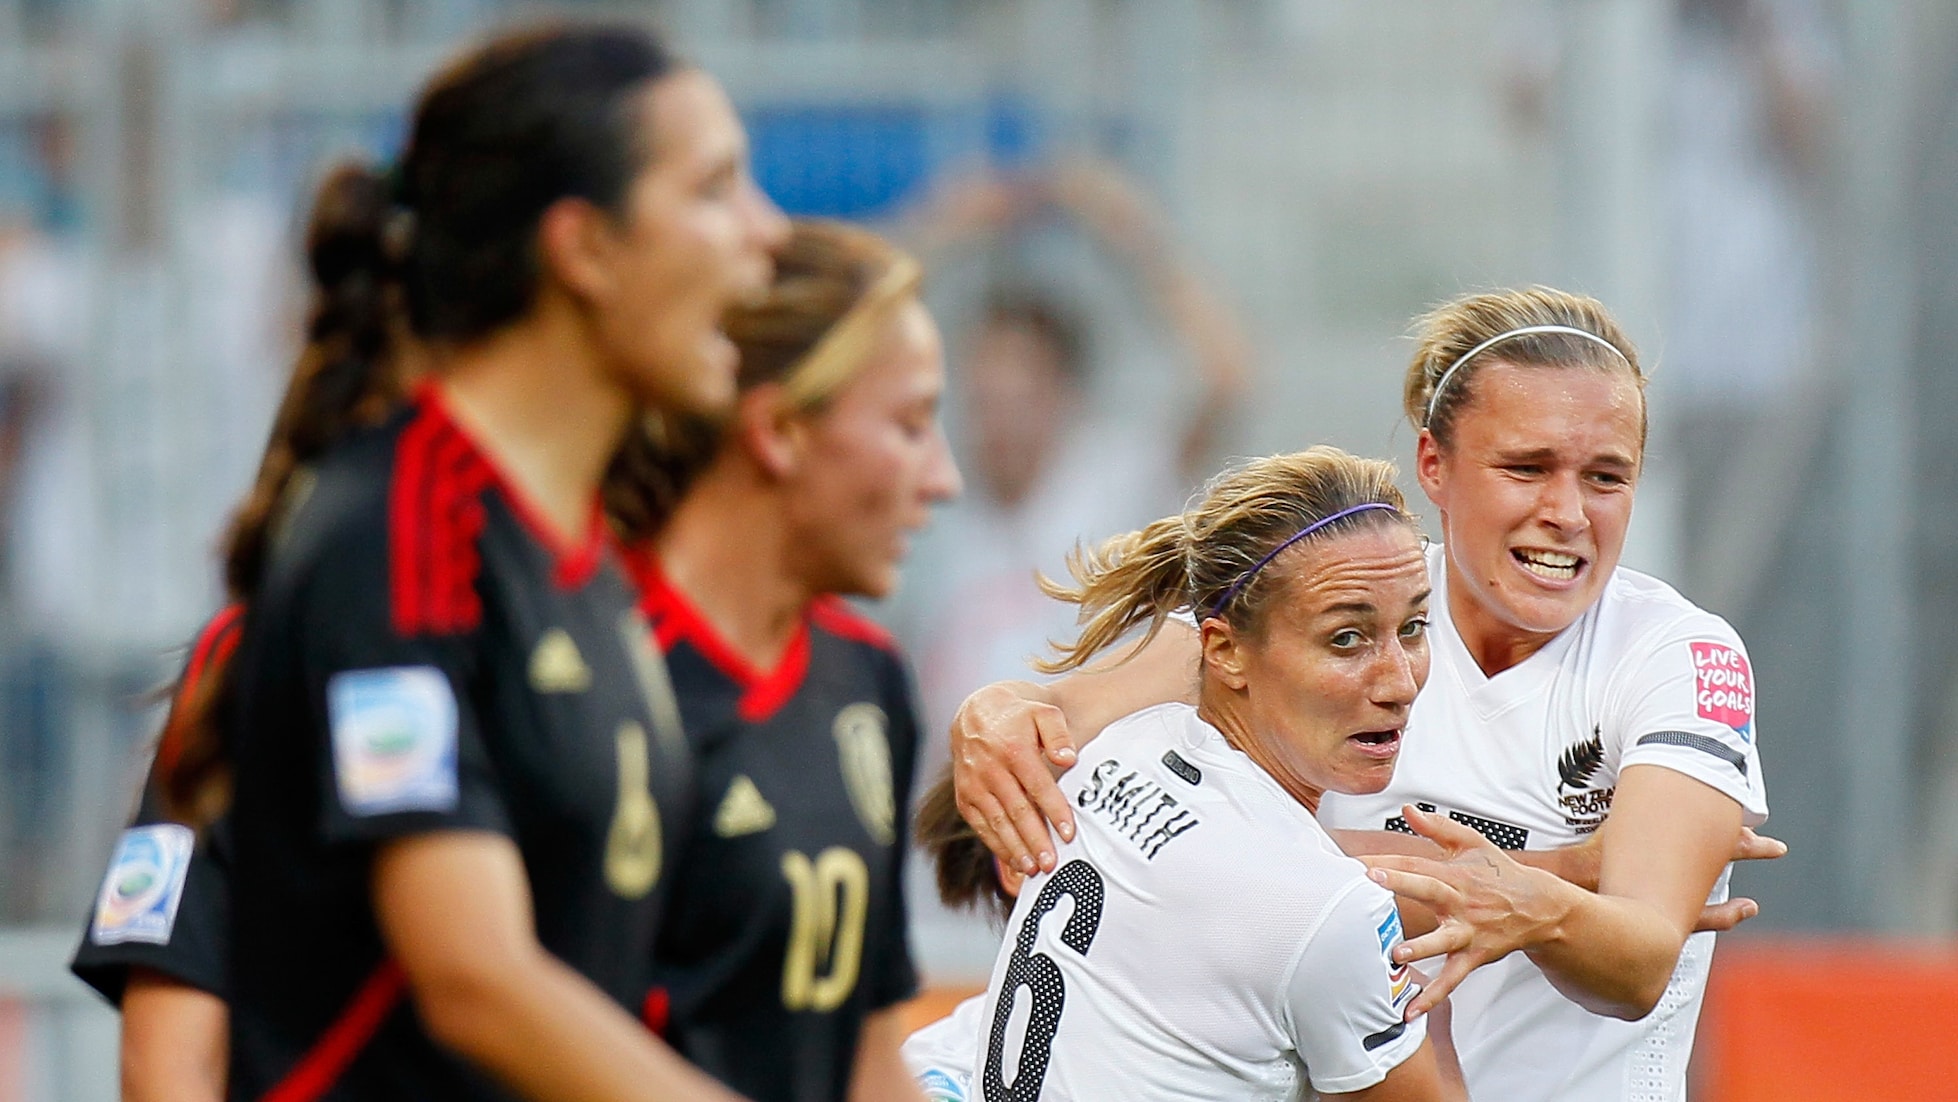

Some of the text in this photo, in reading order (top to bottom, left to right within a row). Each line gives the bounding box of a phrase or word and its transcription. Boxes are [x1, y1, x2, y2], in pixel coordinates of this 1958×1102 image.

[1695, 648, 1740, 668] LIVE
[1697, 669, 1750, 693] YOUR
[1698, 690, 1752, 714] GOALS
[1558, 786, 1616, 808] NEW ZEA
[1077, 758, 1199, 861] SMITH
[781, 845, 870, 1013] 10
[982, 859, 1107, 1102] 6
